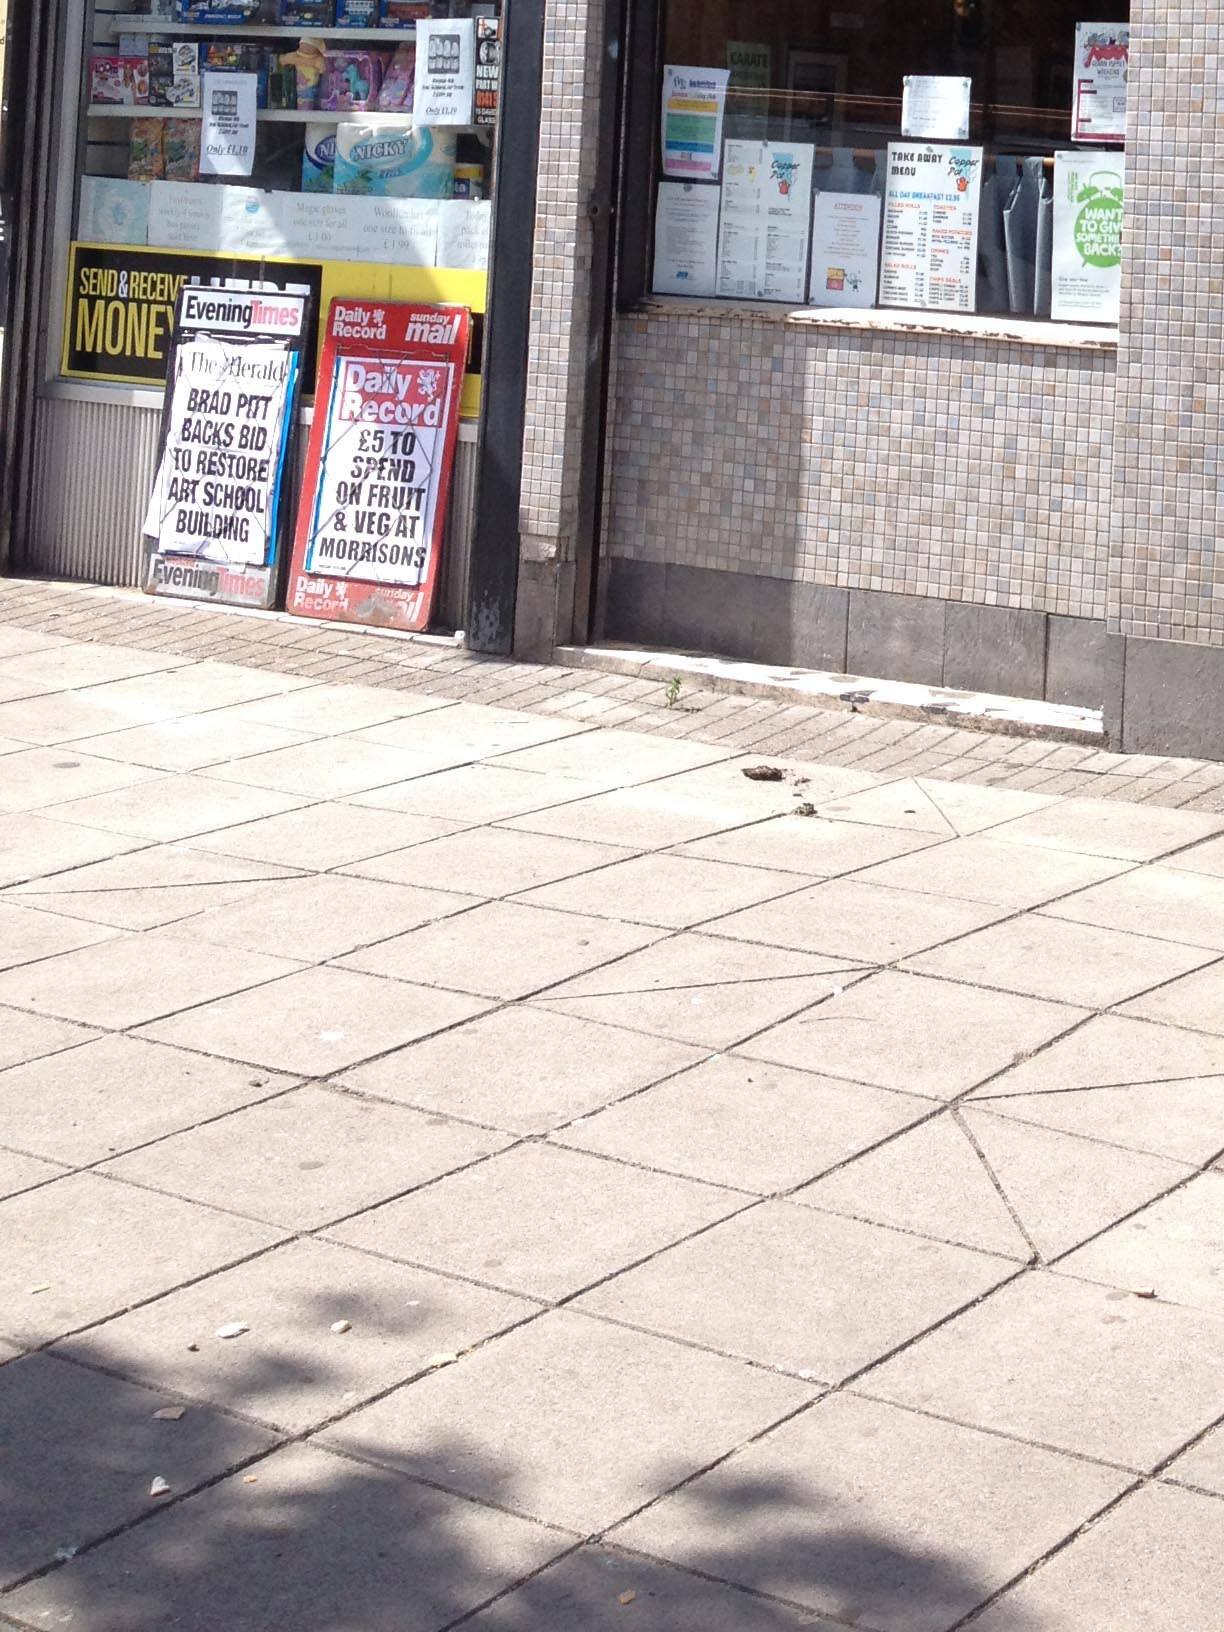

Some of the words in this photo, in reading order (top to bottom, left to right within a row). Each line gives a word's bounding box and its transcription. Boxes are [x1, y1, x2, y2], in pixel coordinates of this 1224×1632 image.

[207, 144, 224, 155] Only
[353, 138, 409, 162] NICKY
[891, 151, 914, 162] TAKE
[917, 153, 943, 163] AWAY
[891, 165, 916, 176] MENU
[1080, 219, 1097, 233] TO
[1099, 221, 1123, 235] GIV
[1084, 207, 1124, 221] WANT
[332, 321, 387, 340] Record
[405, 314, 461, 345] mail
[335, 306, 371, 326] Daily
[410, 312, 450, 324] sunday
[192, 351, 218, 374] The
[225, 355, 288, 383] Herald
[346, 364, 412, 401] Daily
[187, 388, 231, 416] BRAD
[236, 393, 272, 420] PITT
[342, 391, 440, 426] Record
[181, 418, 235, 448] BACKS
[238, 424, 268, 452] BID
[358, 429, 384, 453] £5
[390, 431, 416, 456] TO
[174, 447, 191, 472] TO
[196, 449, 269, 482] RESTORE
[350, 455, 416, 483] SPEND
[168, 477, 199, 504] ART
[203, 481, 265, 513] SCHOOL
[336, 481, 362, 506] ON
[367, 484, 426, 512] FRUIT
[175, 509, 249, 543] BUILDING
[333, 511, 348, 532] &
[354, 510, 391, 537] VEG
[394, 515, 420, 539] AT
[318, 537, 427, 569] MORRISONS
[293, 591, 350, 611] Record
[297, 575, 333, 599] Daily
